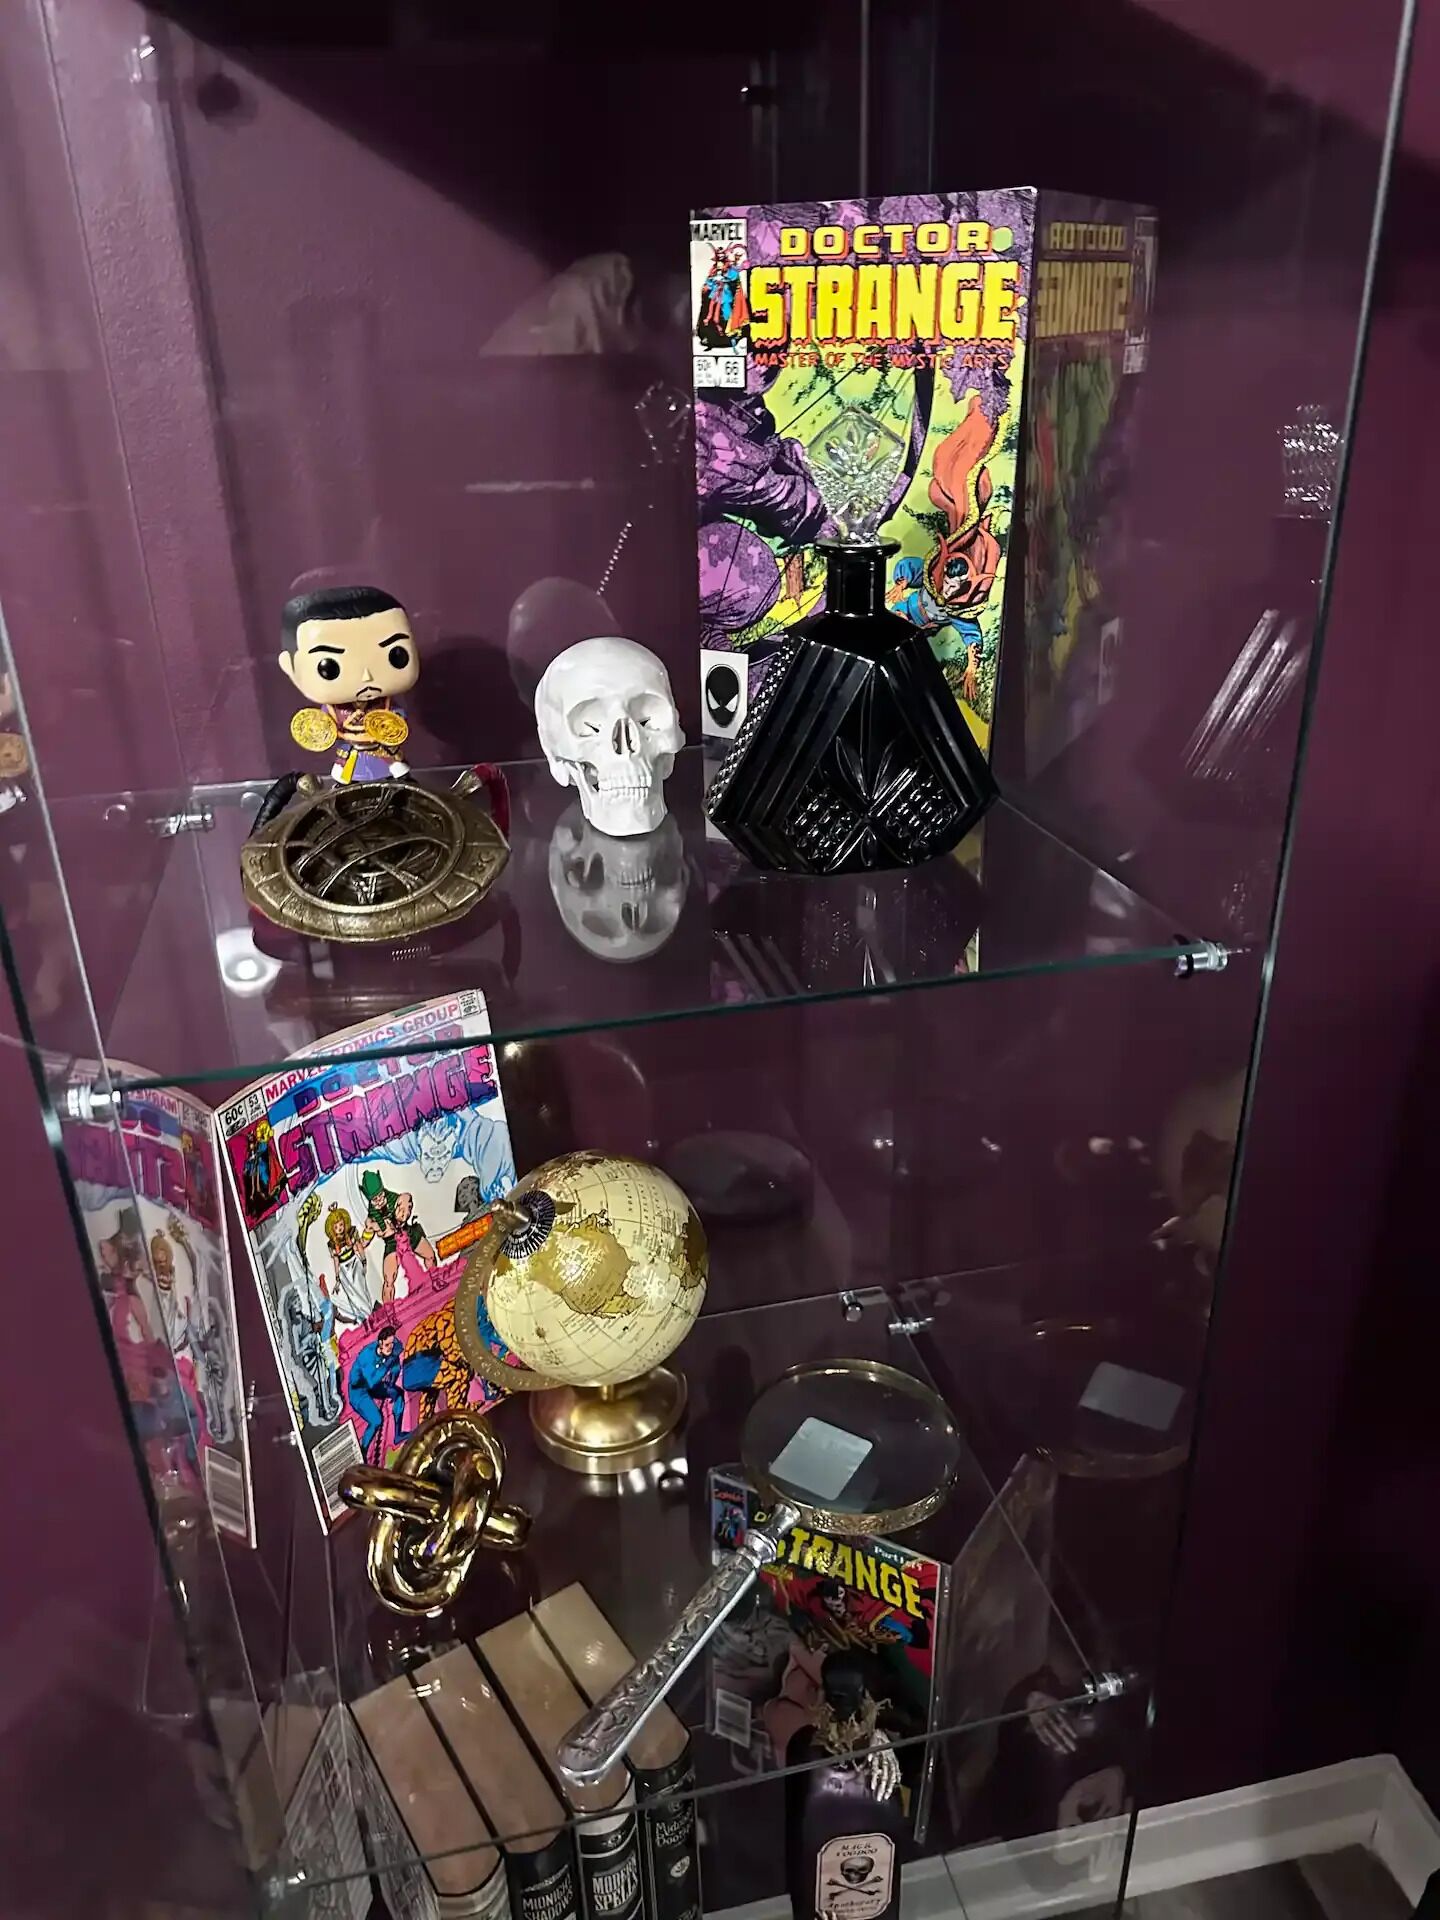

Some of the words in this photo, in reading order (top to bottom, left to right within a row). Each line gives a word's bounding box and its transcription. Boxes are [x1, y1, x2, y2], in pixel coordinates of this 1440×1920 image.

[690, 223, 742, 240] MARVEL
[780, 221, 993, 258] DOCTOR
[749, 260, 1020, 347] STRANGE
[725, 361, 739, 375] 66
[754, 351, 818, 368] MASTER
[825, 352, 846, 367] OF
[853, 352, 883, 368] THE
[891, 352, 953, 368] MYSTIC
[963, 353, 1011, 370] ARTS
[403, 1003, 458, 1034] GROUP
[248, 1093, 259, 1108] 53
[278, 1045, 497, 1193] STRANGE
[777, 1526, 924, 1619] TRANGE
[592, 1853, 637, 1895] MODERN
[594, 1872, 638, 1911] SPELLS
